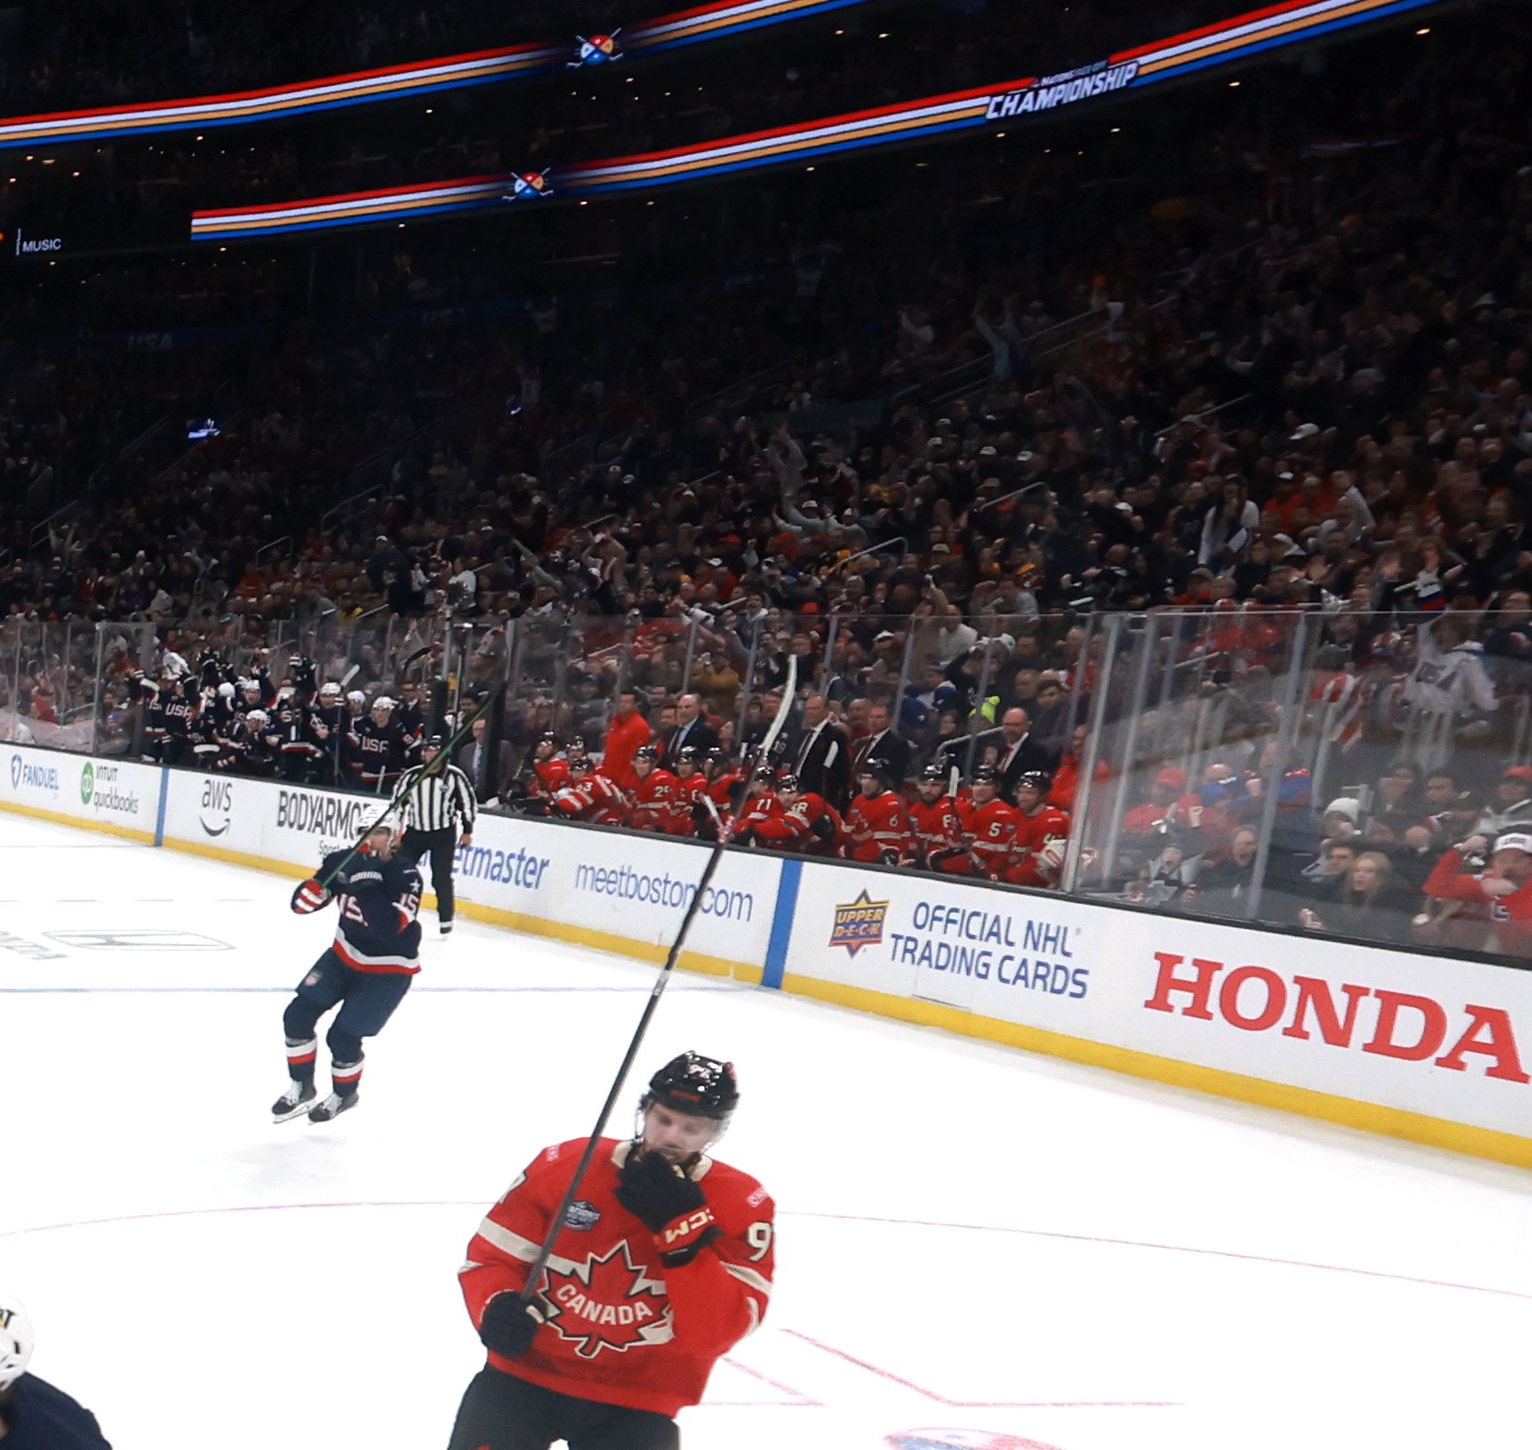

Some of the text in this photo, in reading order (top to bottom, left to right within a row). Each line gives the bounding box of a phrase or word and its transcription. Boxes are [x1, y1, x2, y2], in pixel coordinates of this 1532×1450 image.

[986, 62, 1139, 119] CHAMPIONSHIP
[22, 238, 62, 252] MUSIC
[22, 764, 60, 791] FANDUEL
[95, 764, 119, 782] INTUIT
[93, 781, 139, 815] quickbooks
[202, 778, 233, 811] aws
[756, 798, 772, 811] 71
[277, 790, 373, 841] BODYARMO
[575, 861, 754, 923] meetbostoncom
[836, 909, 883, 925] UPPER
[912, 901, 1073, 958] OFFICIAL NHL
[890, 932, 1089, 999] TRADING CARDS
[1144, 951, 1530, 1085] HONDA
[555, 1282, 654, 1326] CANADA
